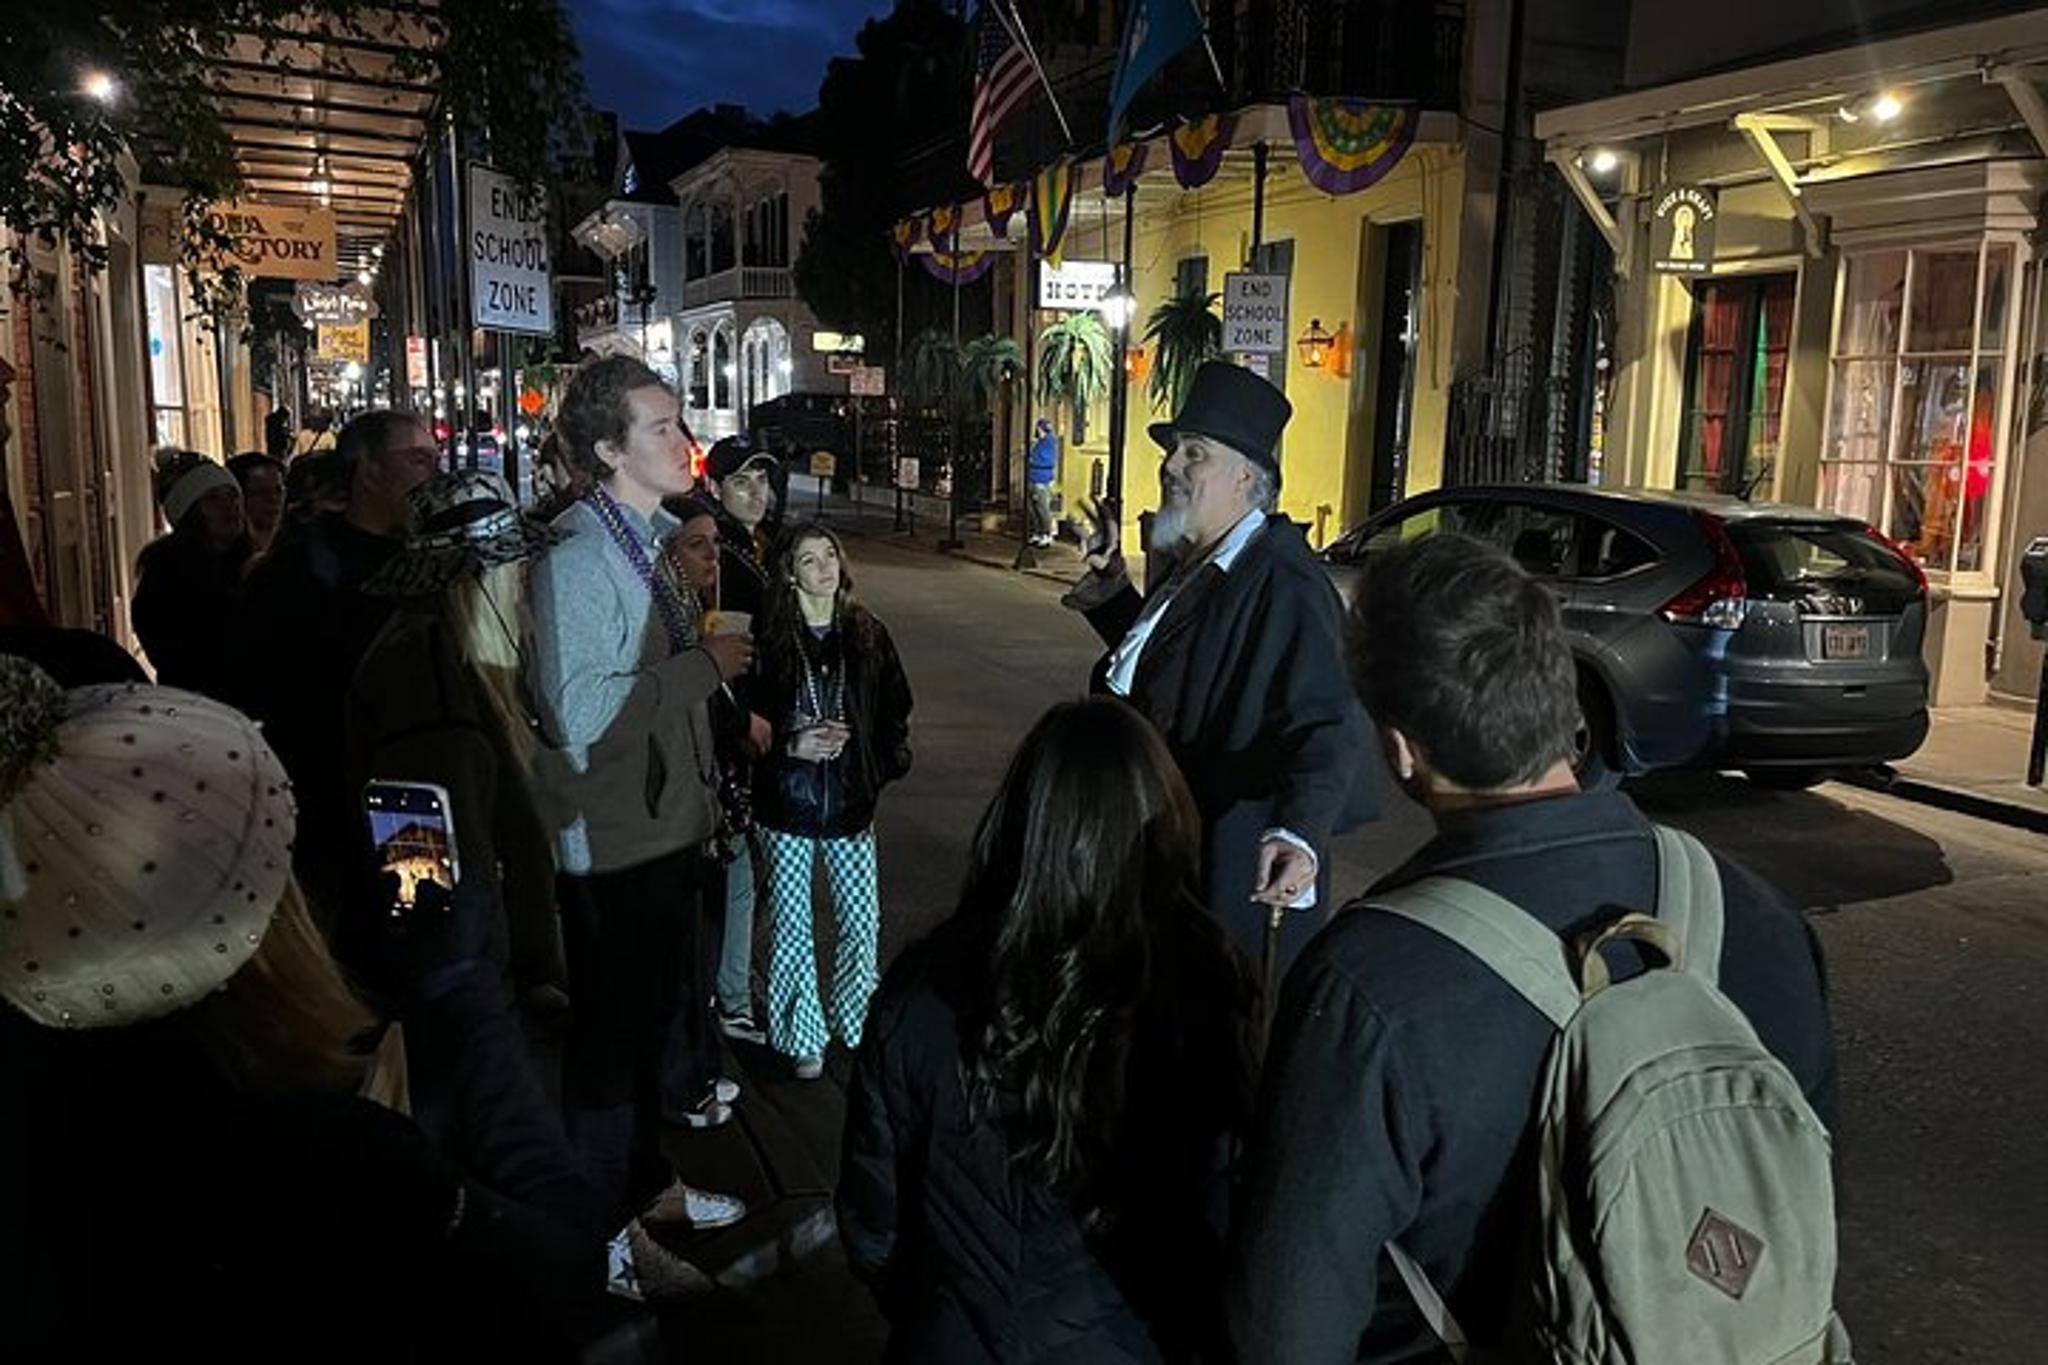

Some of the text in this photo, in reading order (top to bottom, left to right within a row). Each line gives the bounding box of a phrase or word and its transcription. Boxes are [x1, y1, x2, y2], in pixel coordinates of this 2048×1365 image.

[474, 231, 547, 272] SCHOOL
[488, 280, 538, 316] ZONE
[1241, 281, 1272, 297] END
[1226, 304, 1284, 322] SCHOOL
[1233, 328, 1272, 345] ZONE
